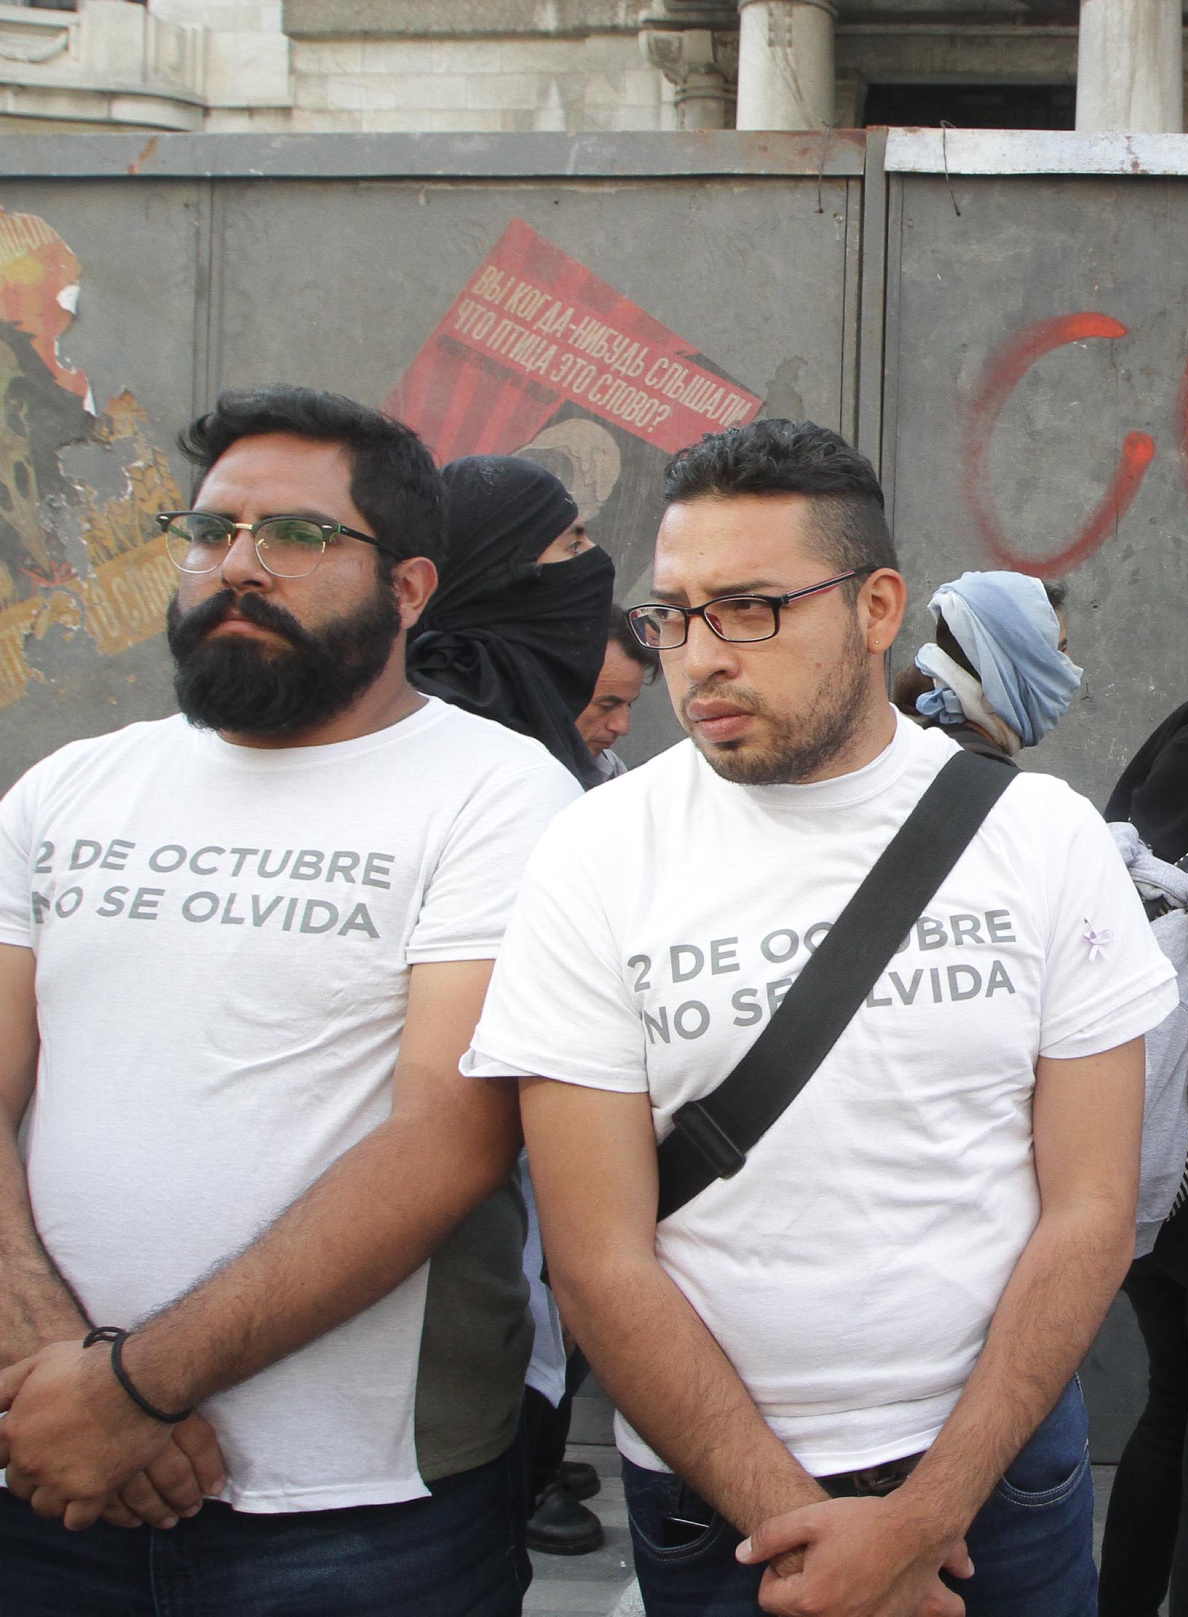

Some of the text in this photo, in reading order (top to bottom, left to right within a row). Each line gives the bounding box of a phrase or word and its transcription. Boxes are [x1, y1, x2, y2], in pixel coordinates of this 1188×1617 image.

[472, 265, 516, 304] ВЫ
[503, 281, 649, 378] КОГДА-НИБУДЬ
[454, 299, 672, 433] ЧТО ПТИЦА ЭТО СЛОВО?
[34, 838, 396, 890] 2 DE OCTUBRE
[96, 885, 166, 920] SE
[181, 890, 381, 939] OLVIDA
[626, 953, 652, 993] 2
[669, 936, 741, 984] DE
[643, 1000, 710, 1045] NO
